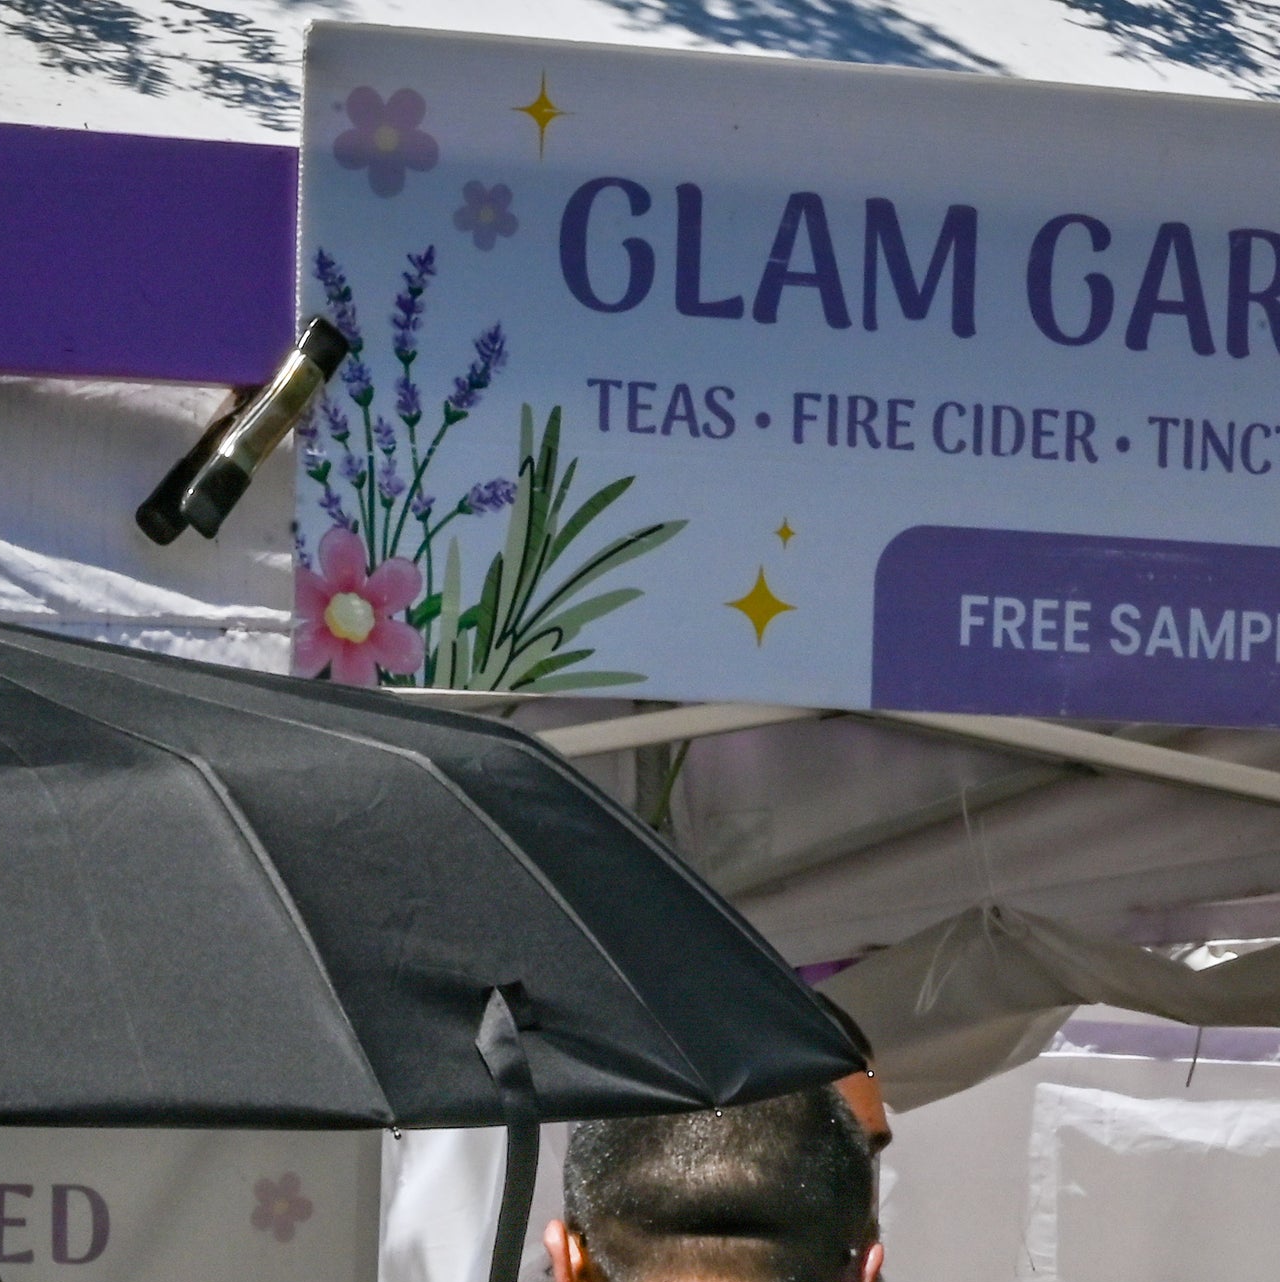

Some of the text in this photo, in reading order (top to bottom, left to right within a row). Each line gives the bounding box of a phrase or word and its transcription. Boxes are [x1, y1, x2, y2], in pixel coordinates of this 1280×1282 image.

[559, 176, 978, 340] GLAM
[587, 378, 736, 440] TEAS
[791, 392, 916, 452] FIRE
[931, 401, 1099, 464] CIDER
[960, 594, 1092, 653] FREE
